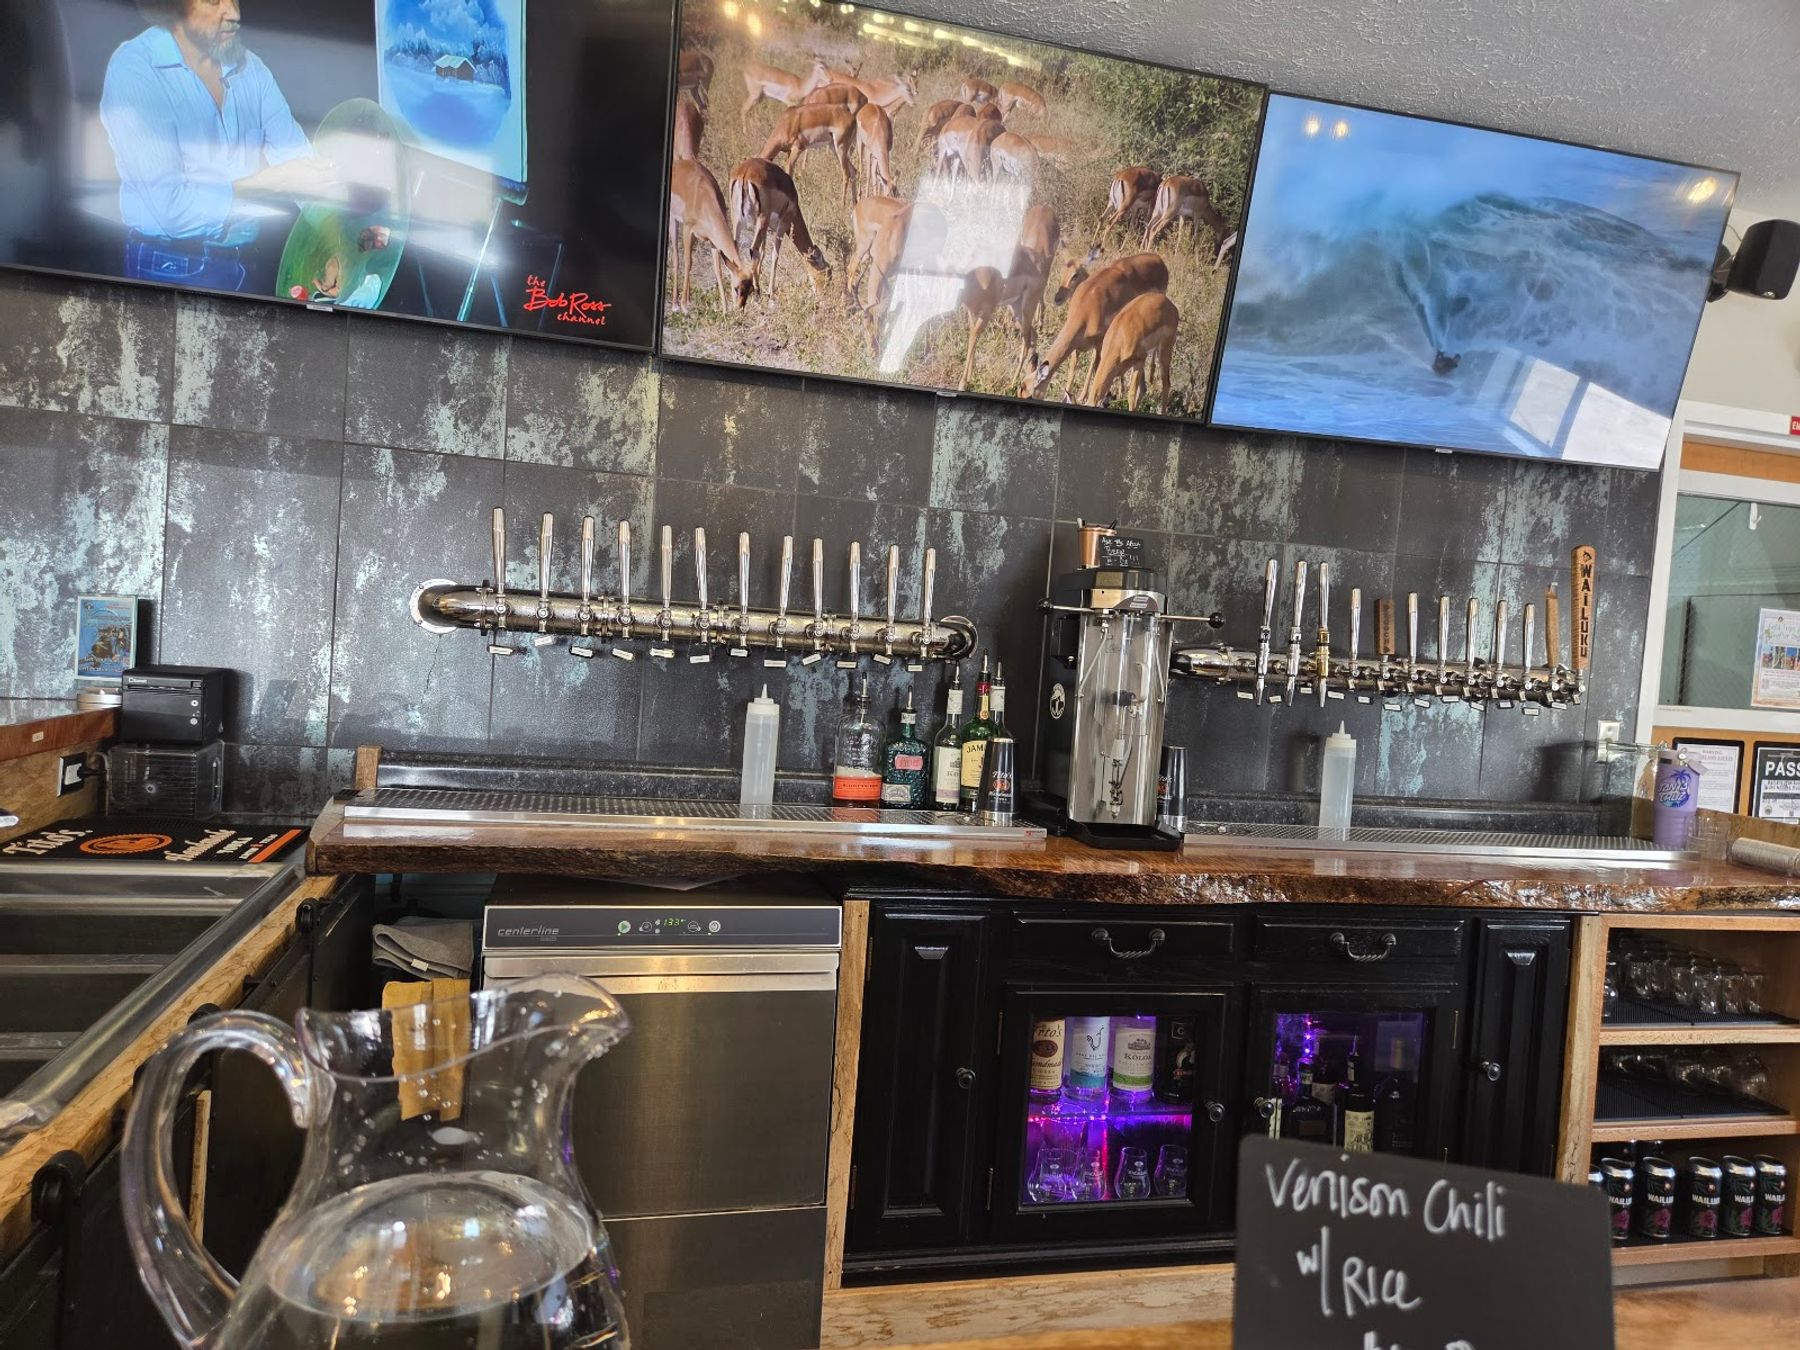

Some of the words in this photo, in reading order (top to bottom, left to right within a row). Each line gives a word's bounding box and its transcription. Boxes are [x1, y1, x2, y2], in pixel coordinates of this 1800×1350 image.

[527, 275, 546, 287] the
[523, 286, 568, 311] Bob
[569, 293, 612, 318] Ross
[557, 312, 606, 326] channel
[1580, 564, 1592, 657] WAILUKU
[966, 744, 984, 753] JAM
[497, 924, 560, 937] centerline
[1265, 1154, 1409, 1219] Venison
[1424, 1179, 1507, 1241] Chili
